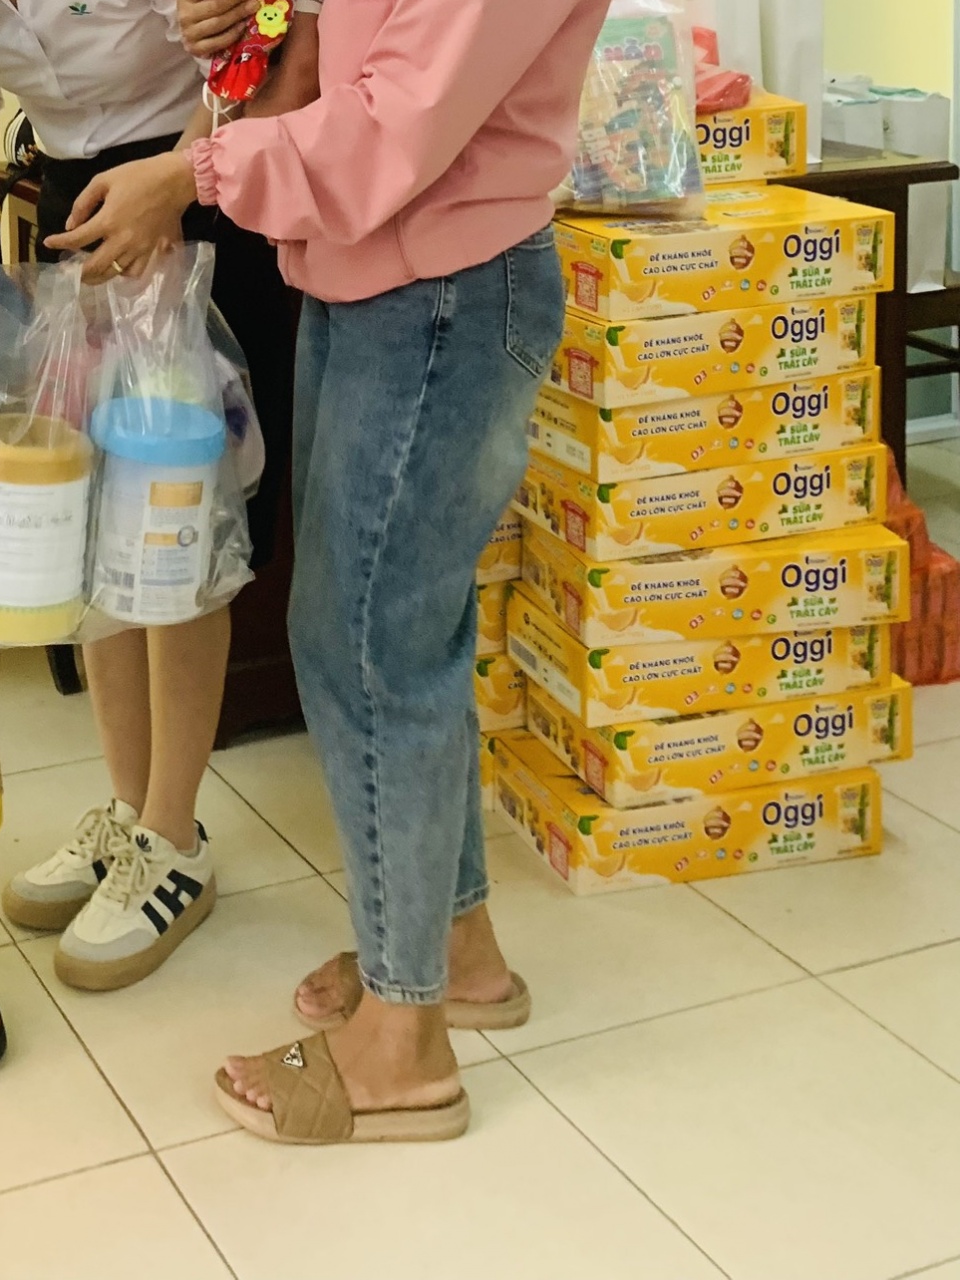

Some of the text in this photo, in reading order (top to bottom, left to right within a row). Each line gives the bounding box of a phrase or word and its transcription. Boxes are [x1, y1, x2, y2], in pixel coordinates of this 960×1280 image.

[702, 163, 722, 174] RÁI
[783, 229, 840, 262] Oggi
[643, 266, 660, 275] CAO
[771, 308, 825, 342] Oggi
[637, 352, 654, 361] CAO
[772, 385, 828, 418] Oggi
[631, 428, 648, 437] CAO
[773, 465, 830, 498] Oggi
[630, 509, 647, 517] CAO
[781, 559, 846, 592] Oggi
[771, 630, 832, 664] Oggi
[794, 705, 853, 739] Oggi
[762, 793, 823, 828] Oggi
